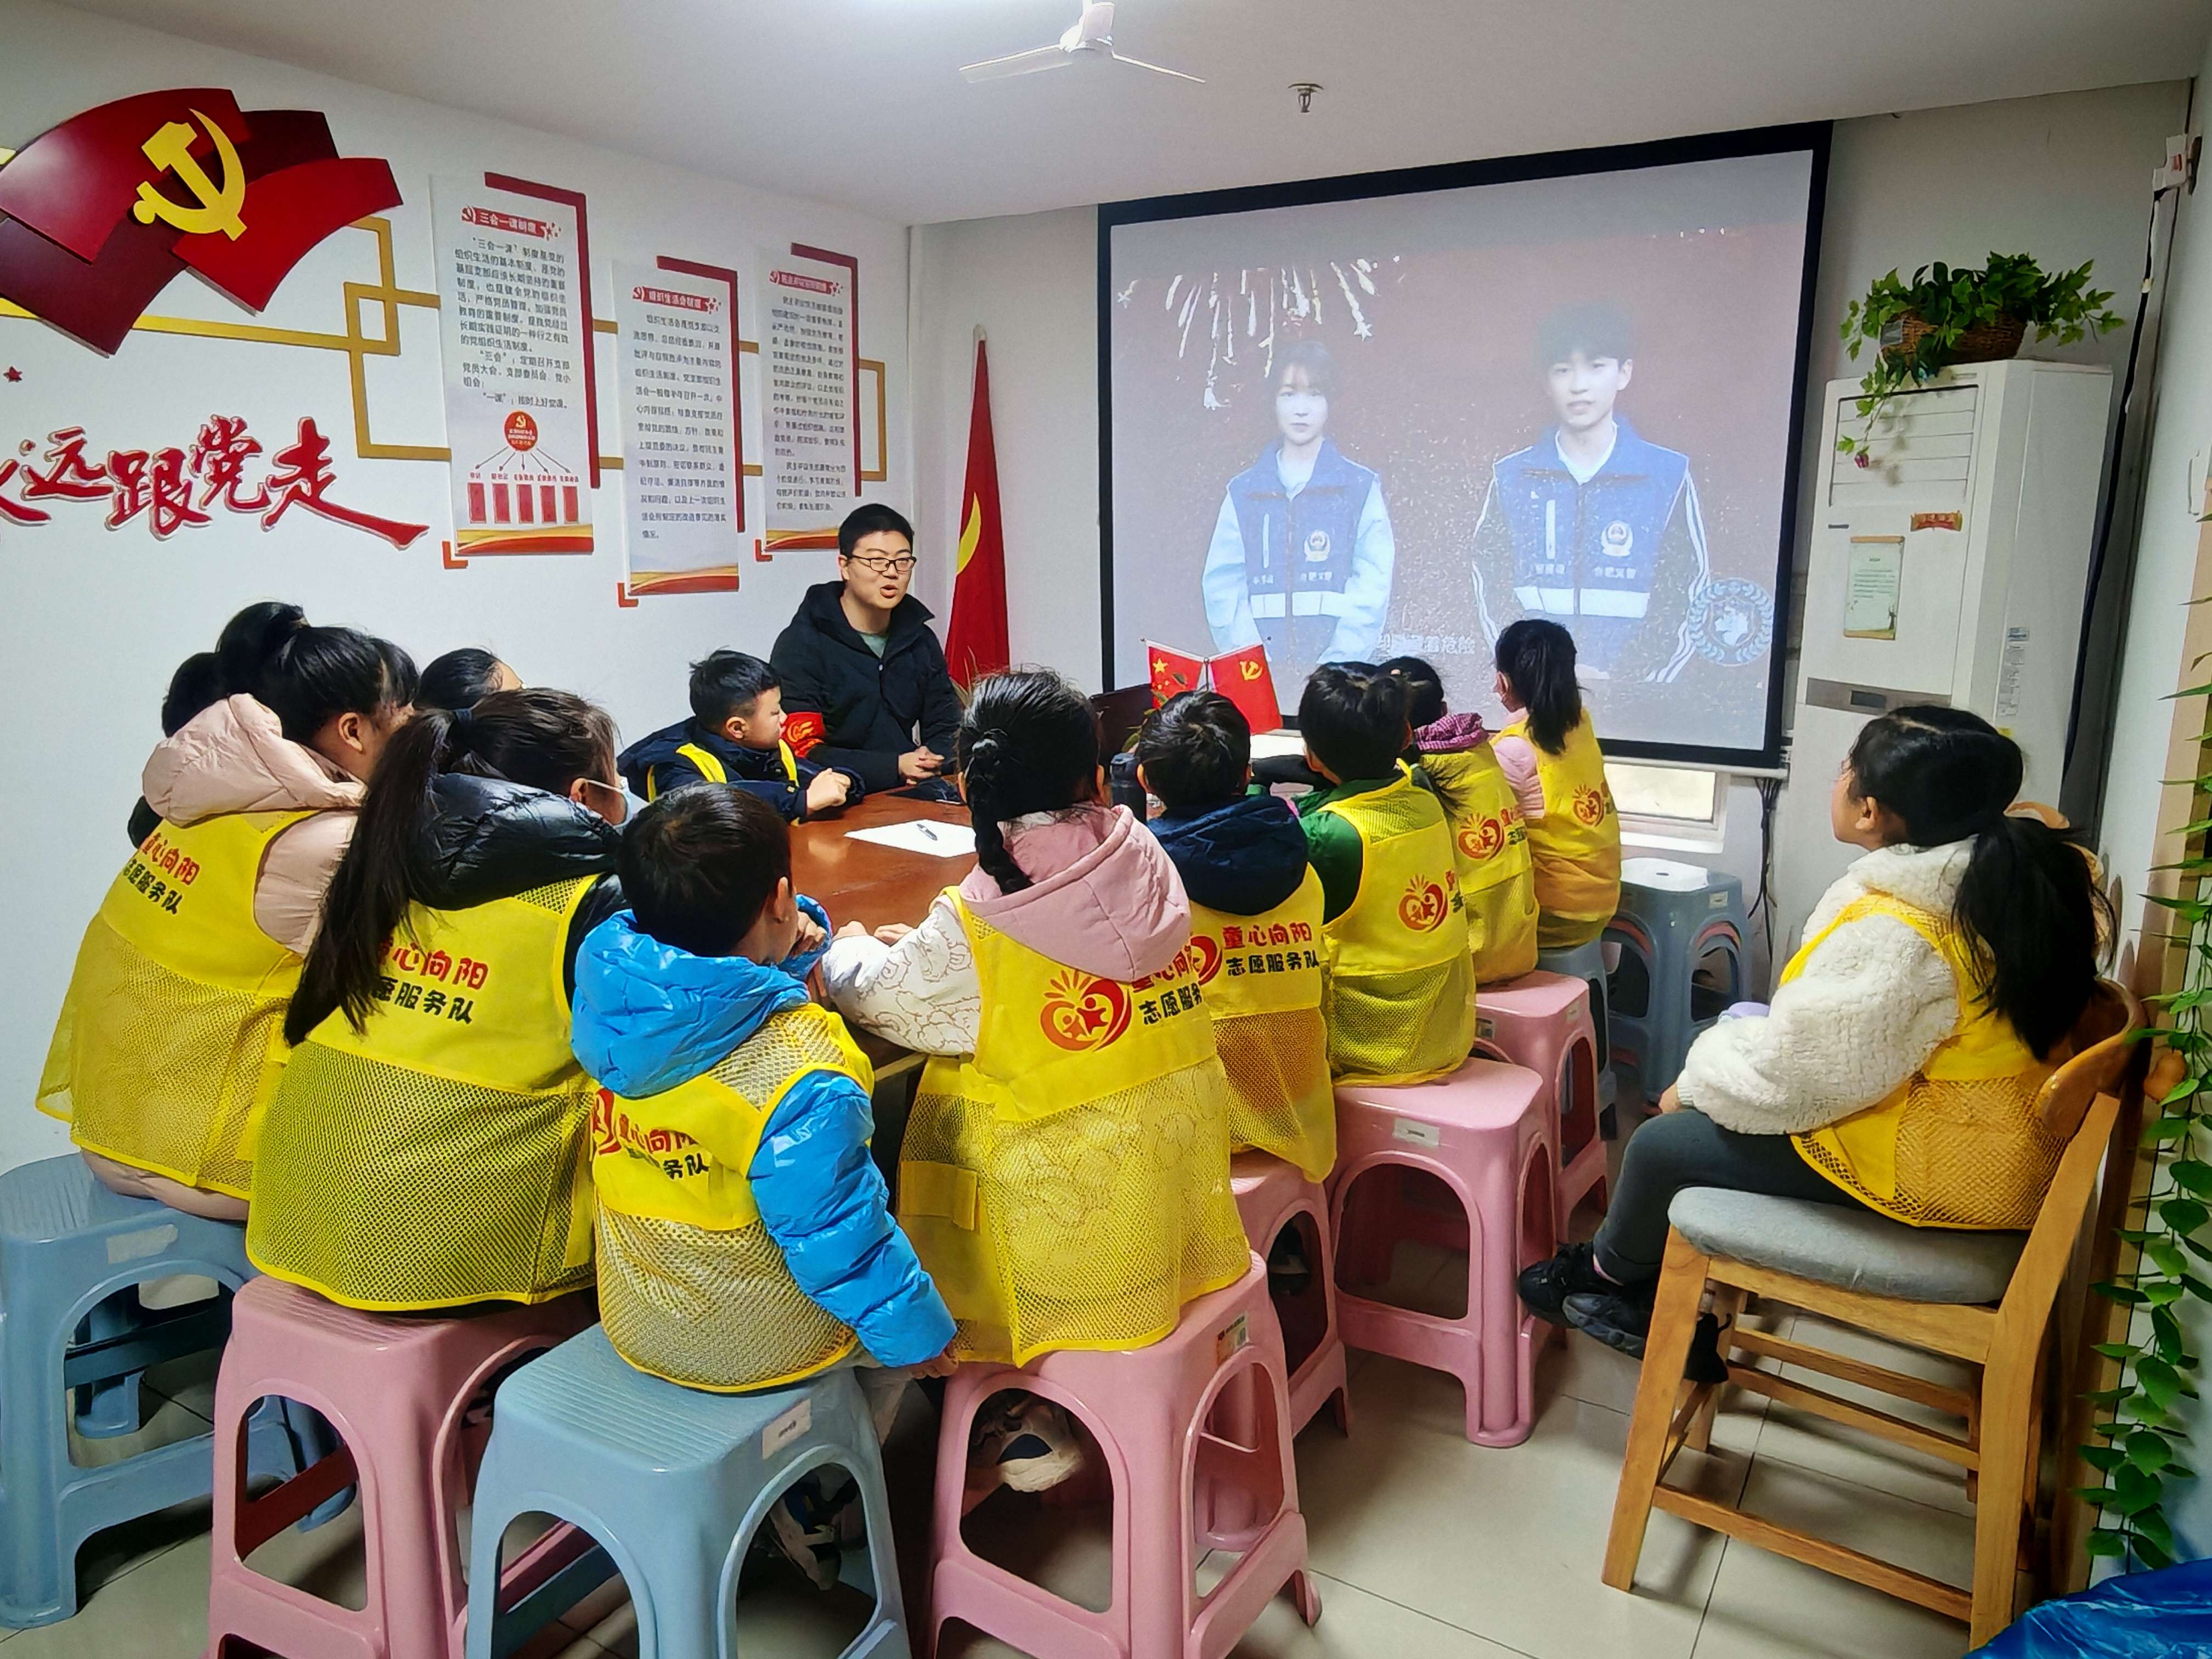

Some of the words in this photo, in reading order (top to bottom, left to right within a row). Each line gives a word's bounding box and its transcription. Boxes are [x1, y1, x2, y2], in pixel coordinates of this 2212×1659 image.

[1222, 922, 1312, 950] 童心向阳
[1226, 950, 1319, 977] 志愿服务队
